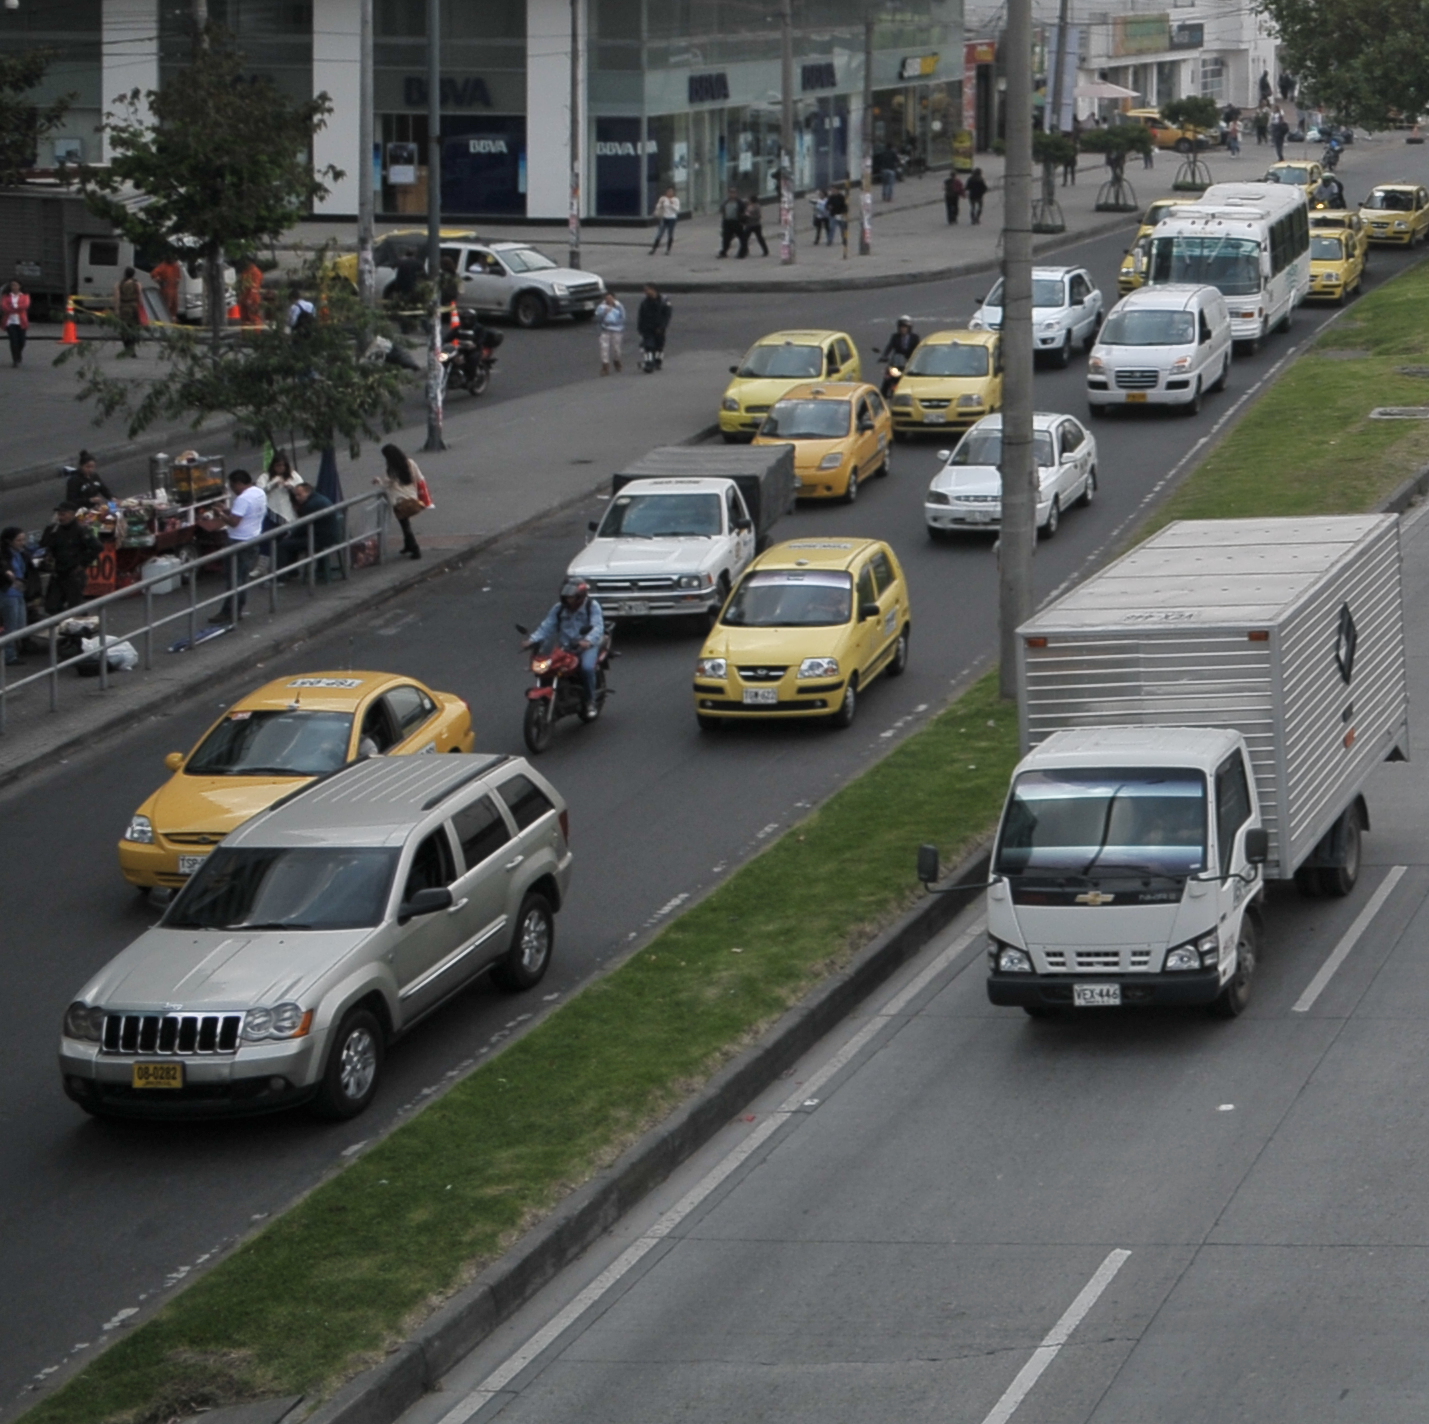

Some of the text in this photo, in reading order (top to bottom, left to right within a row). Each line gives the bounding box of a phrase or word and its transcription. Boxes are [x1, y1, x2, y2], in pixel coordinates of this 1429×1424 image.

[689, 72, 729, 104] BBVA
[469, 139, 508, 153] BBVA
[597, 141, 635, 155] BBVA
[1075, 986, 1119, 1001] VEX-446
[137, 1062, 177, 1080] 08-0282
